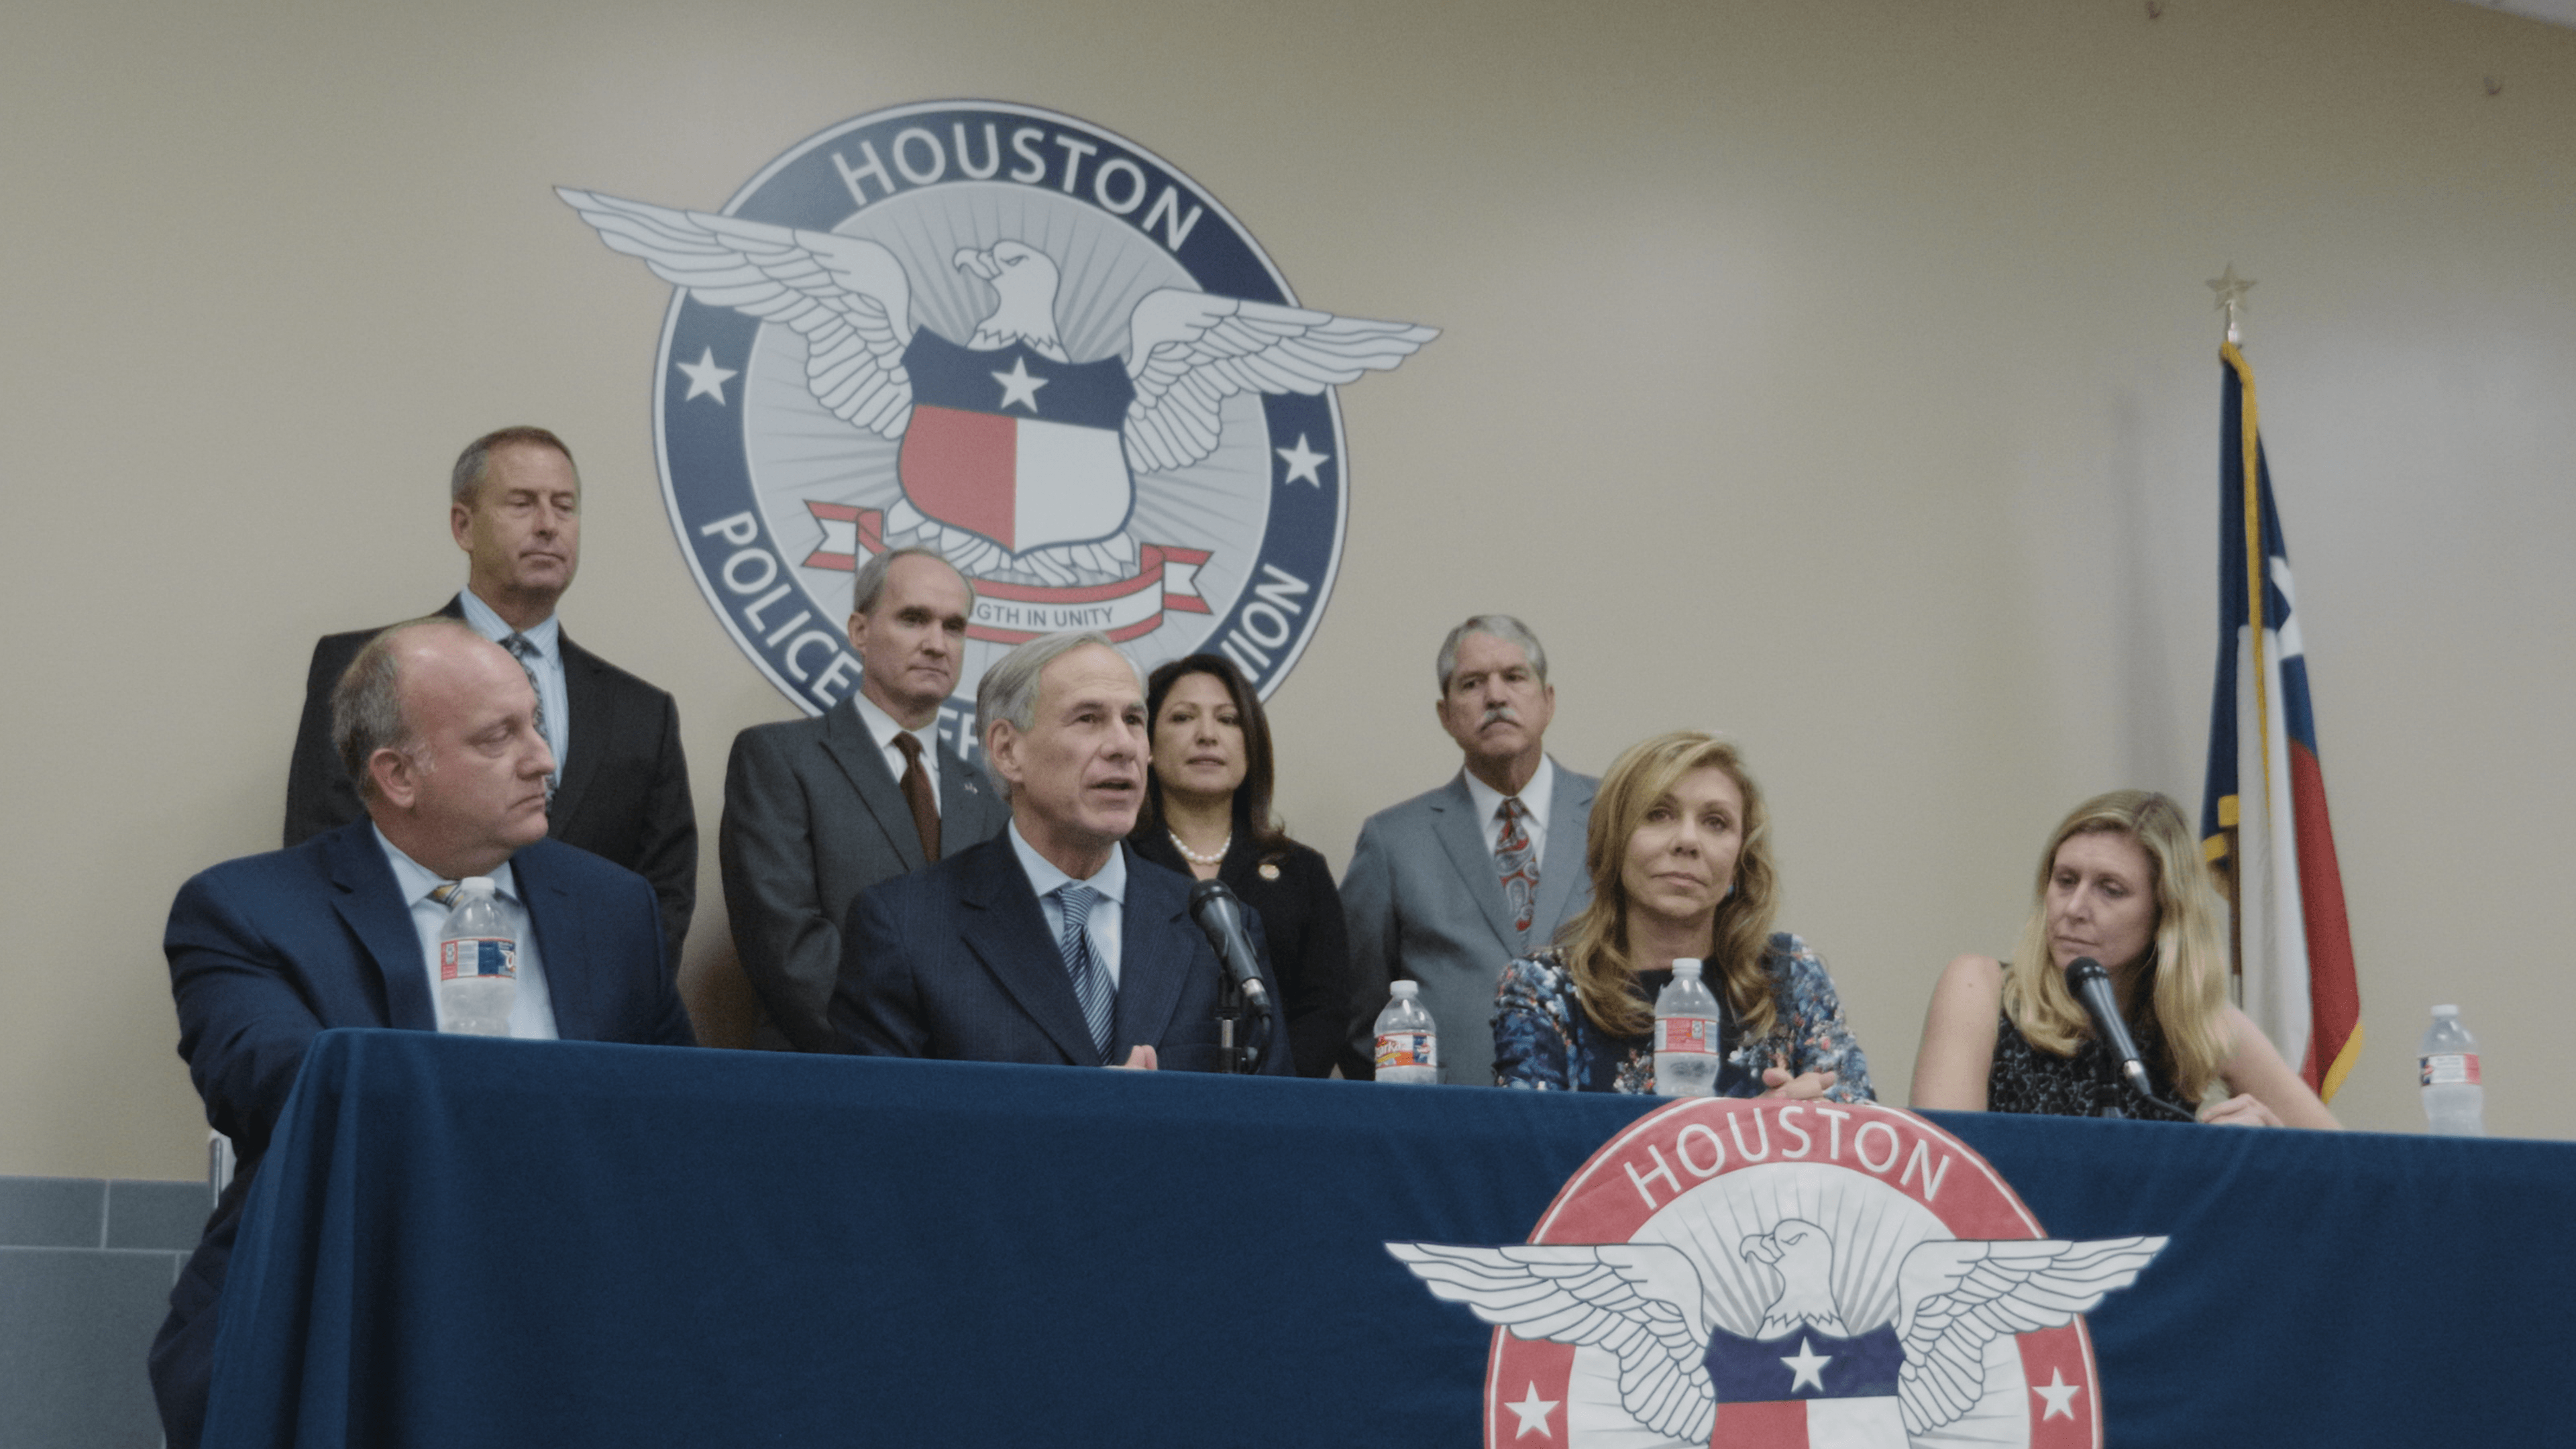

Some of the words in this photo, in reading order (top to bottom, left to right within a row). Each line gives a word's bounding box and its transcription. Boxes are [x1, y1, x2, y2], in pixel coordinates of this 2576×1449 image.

[830, 123, 1203, 252] HOUSTON
[701, 511, 864, 707] POLICE
[1027, 608, 1046, 627] IN
[1054, 606, 1113, 627] UNITY
[1220, 564, 1310, 684] ION
[1623, 1106, 1950, 1211] HOUSTON
